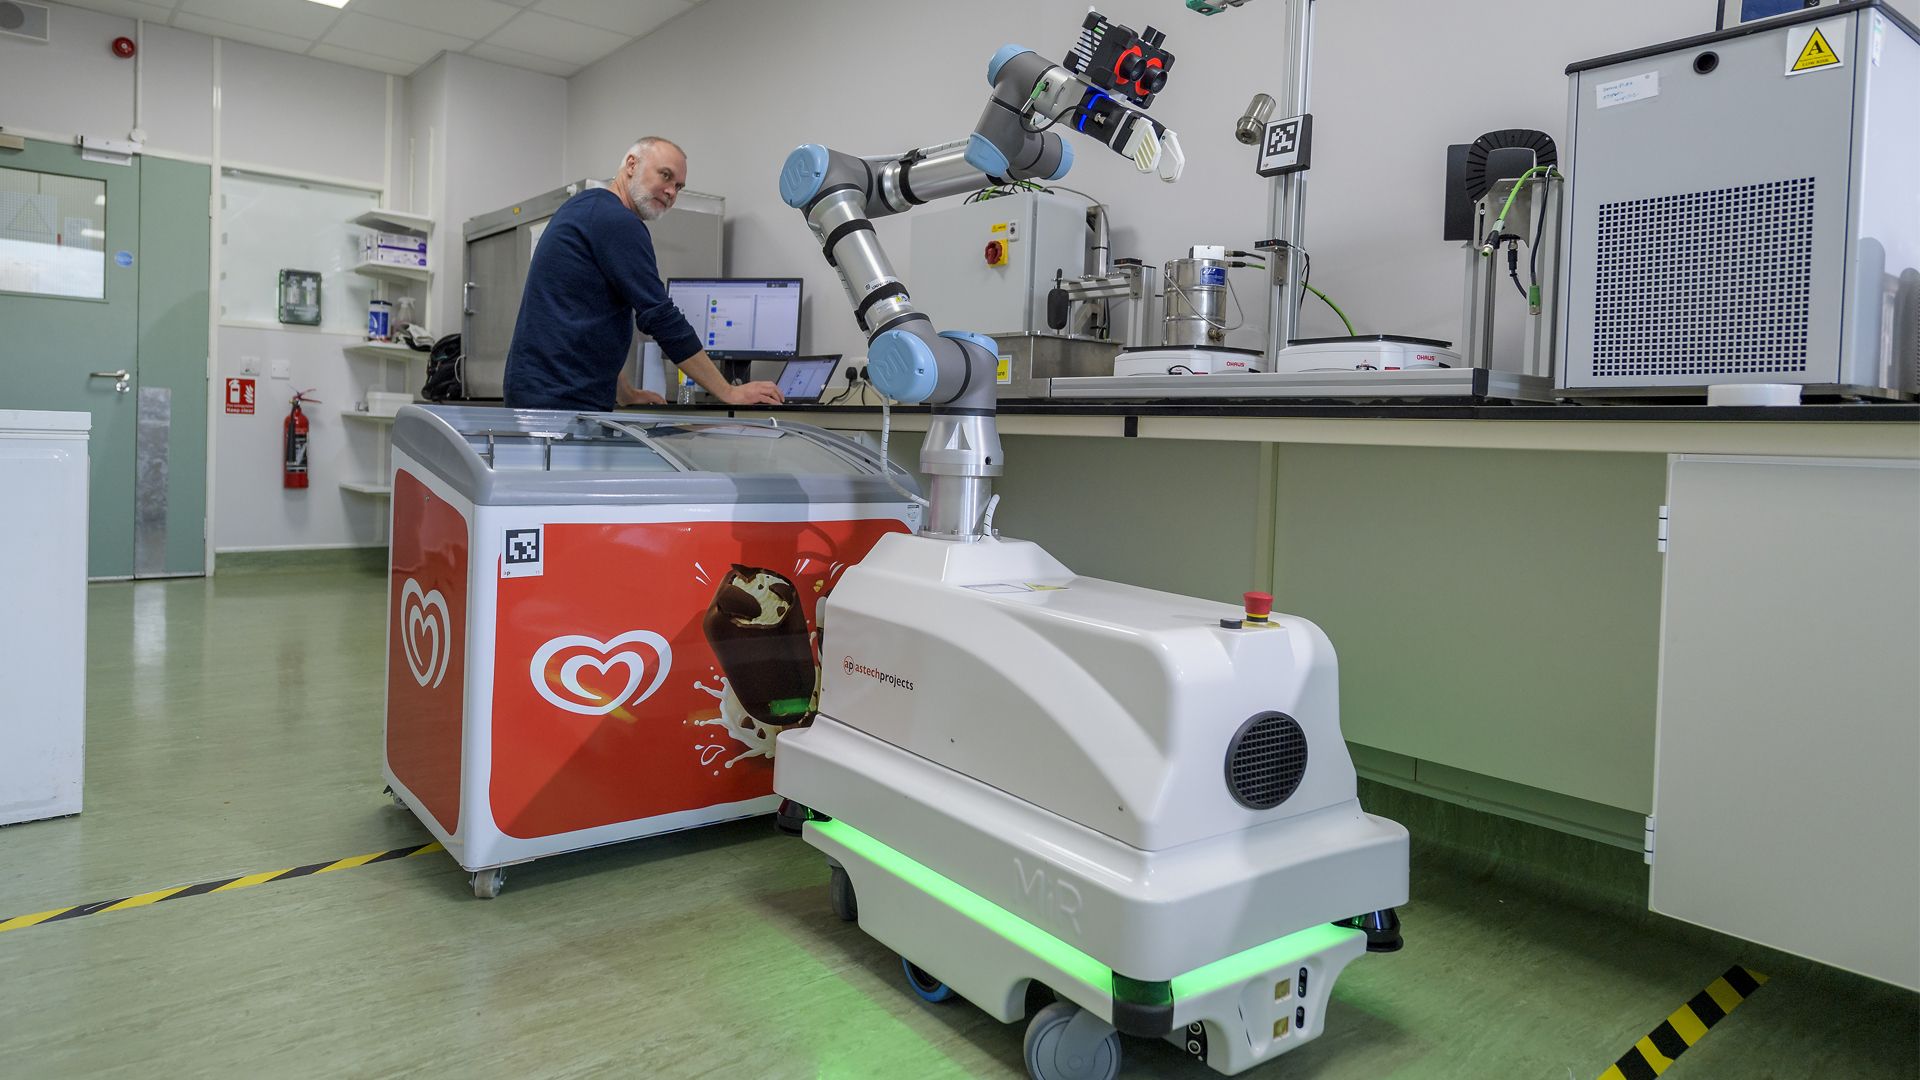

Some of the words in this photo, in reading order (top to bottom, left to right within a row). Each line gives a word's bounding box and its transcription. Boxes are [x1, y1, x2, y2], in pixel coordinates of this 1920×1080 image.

[1806, 40, 1825, 56] A
[844, 658, 854, 675] ap
[855, 663, 914, 691] astechprojects
[1013, 857, 1083, 936] MiR
